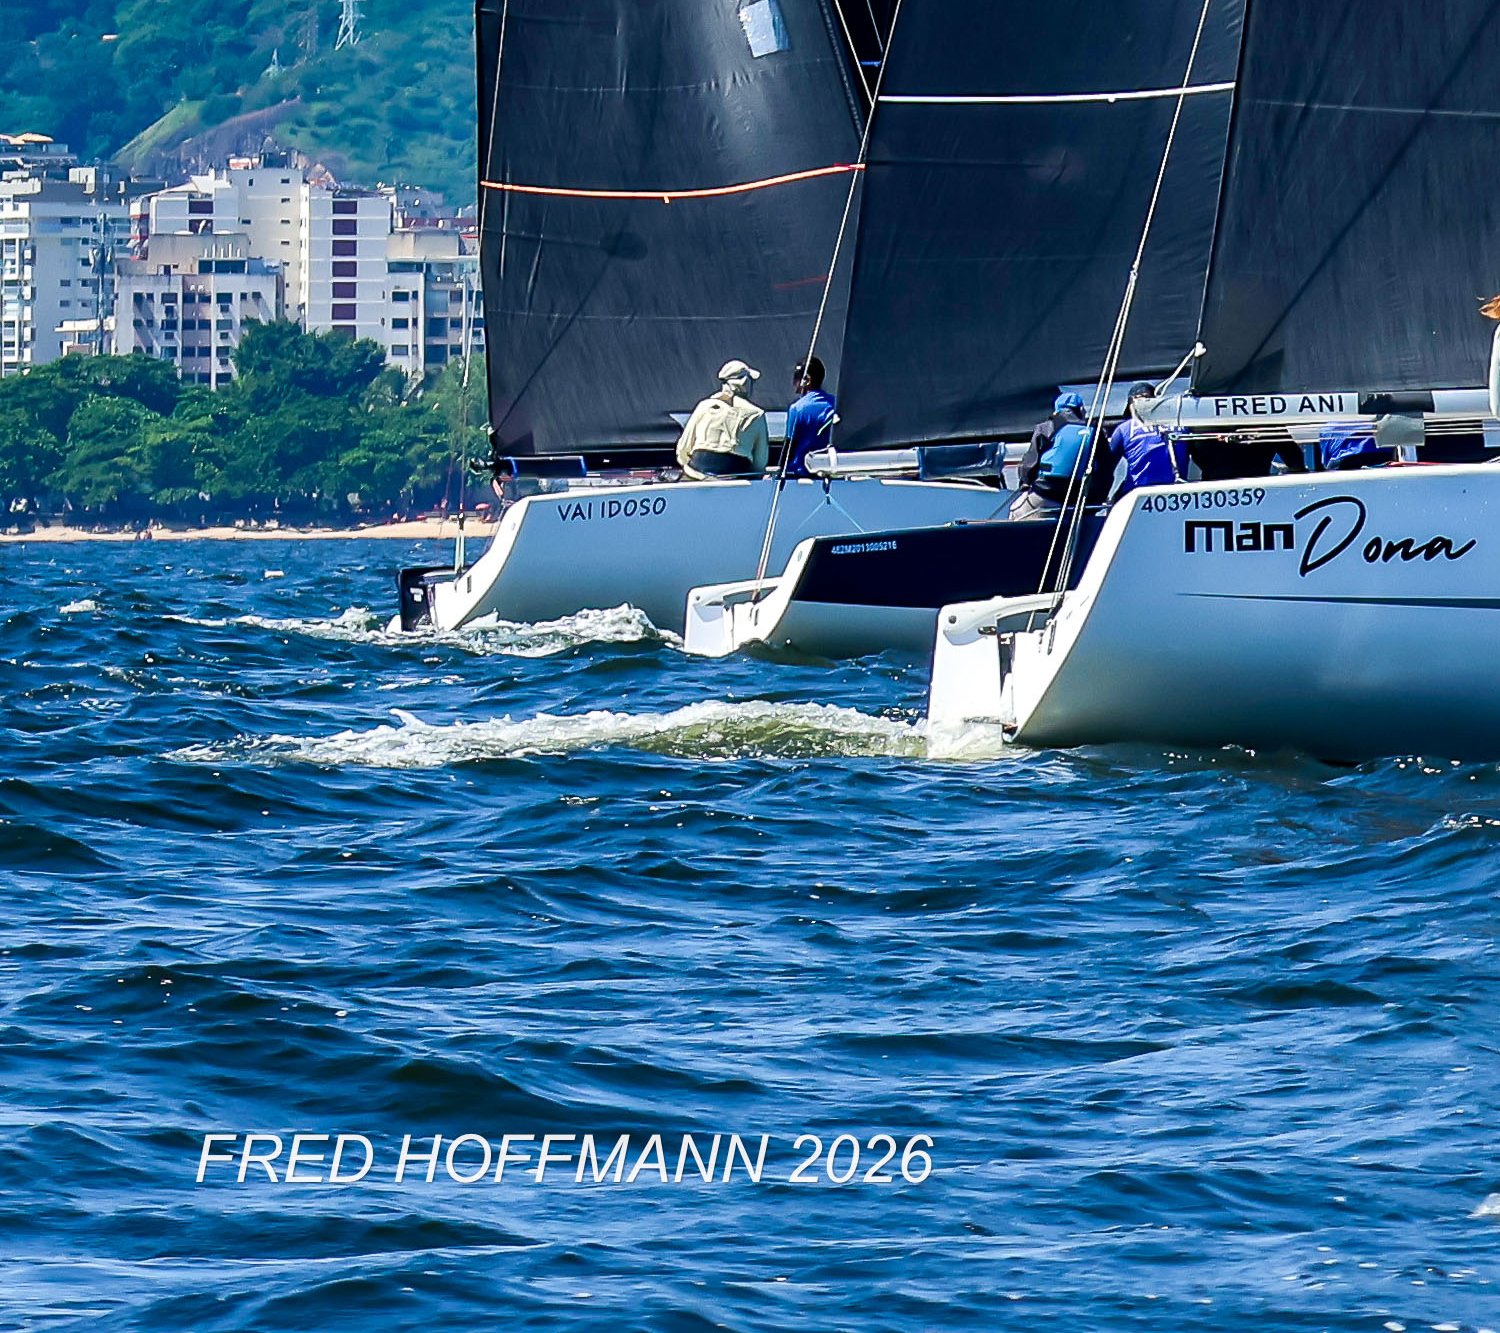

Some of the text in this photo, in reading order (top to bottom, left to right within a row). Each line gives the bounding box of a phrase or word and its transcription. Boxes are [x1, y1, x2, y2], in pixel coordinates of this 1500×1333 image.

[1214, 394, 1344, 416] FRED ANI
[558, 497, 667, 521] VAI IDOSO
[1141, 488, 1266, 513] 4039130359
